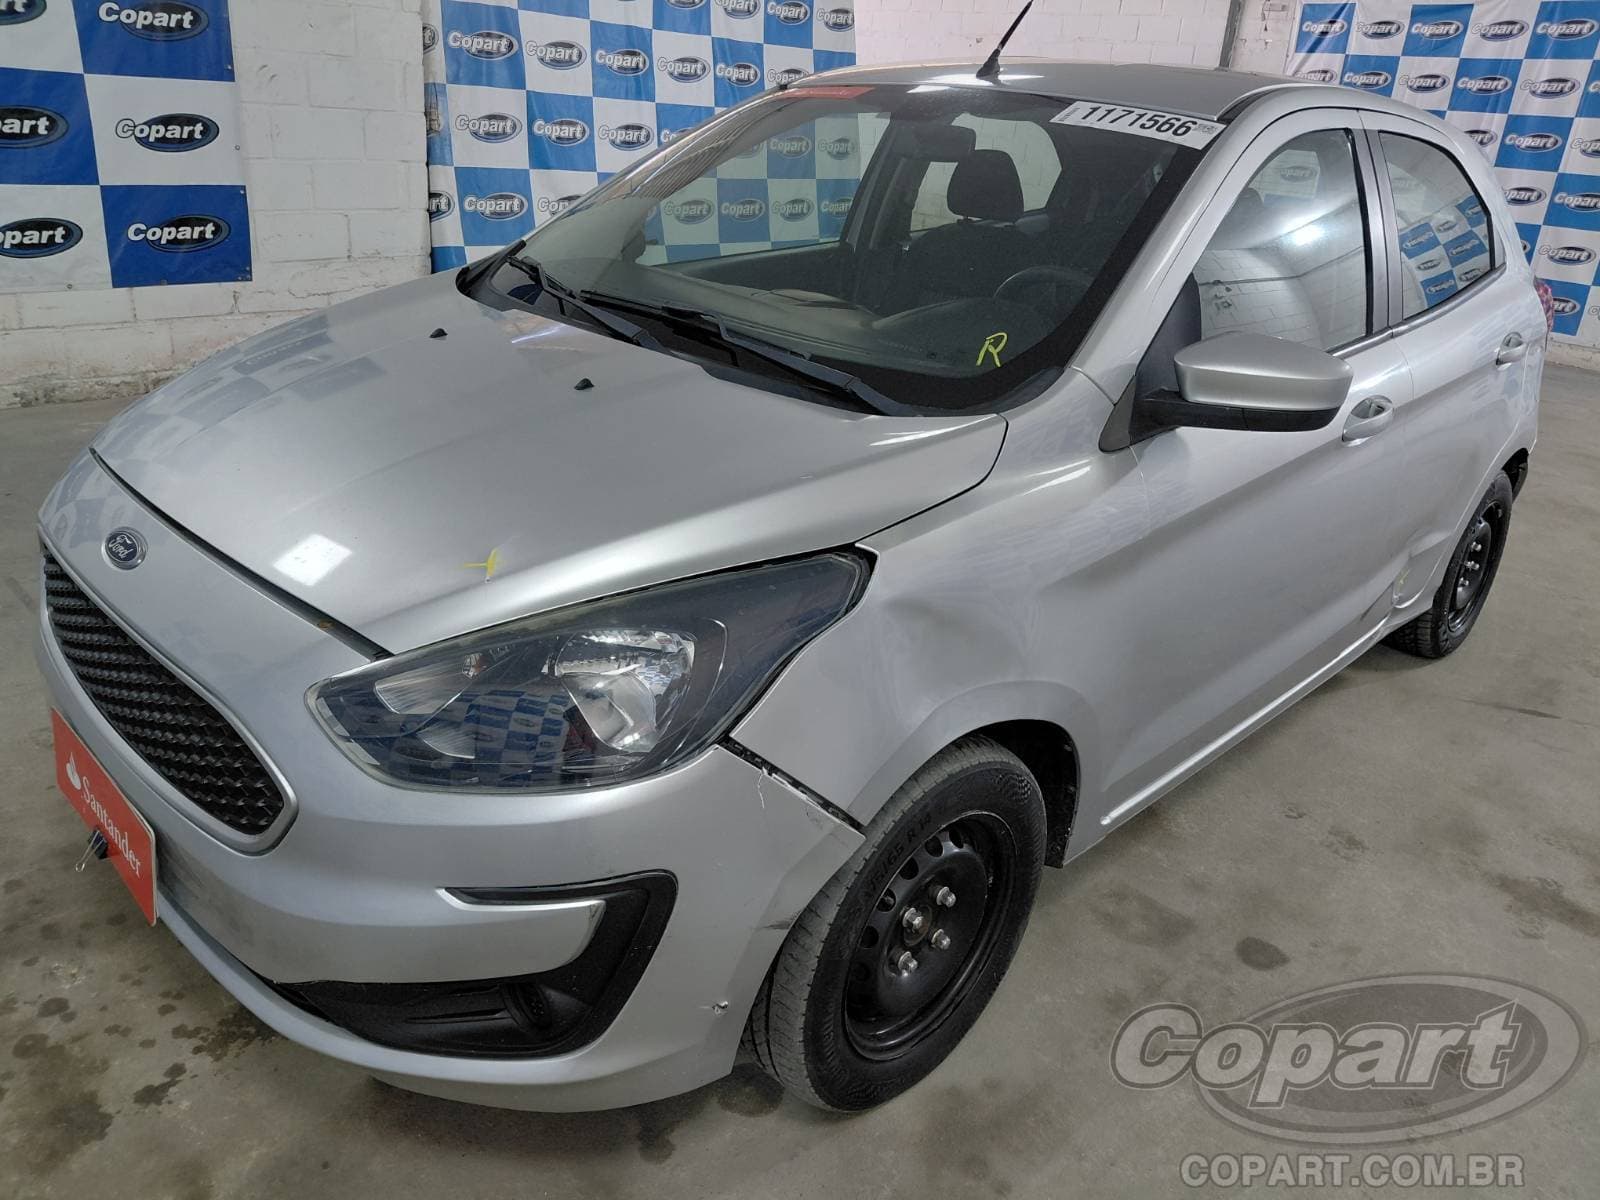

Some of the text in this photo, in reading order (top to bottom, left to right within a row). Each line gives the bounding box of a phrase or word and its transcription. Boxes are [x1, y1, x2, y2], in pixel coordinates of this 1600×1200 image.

[99, 2, 194, 28] Copart
[767, 2, 805, 19] Copart
[817, 9, 854, 25] Copart
[1356, 22, 1397, 34] Copart
[1411, 22, 1455, 36] Copart
[1472, 23, 1519, 36] Copart
[1537, 21, 1591, 36] Copart
[449, 32, 508, 53] Copart
[526, 41, 581, 62] Copart
[595, 51, 646, 69] Copart
[657, 57, 703, 76] Copart
[716, 65, 755, 82] Copart
[1343, 73, 1385, 86] Copart
[1400, 74, 1443, 88] Copart
[1457, 77, 1504, 92] Copart
[1520, 80, 1572, 94] Copart
[456, 115, 513, 134] Copart
[533, 120, 583, 138] Copart
[1082, 105, 1197, 137] 1171566
[116, 119, 203, 141] Copart
[598, 126, 647, 143] Copart
[1505, 134, 1554, 149] Copart
[464, 197, 521, 213] Copart
[1554, 192, 1600, 208] Copar
[0, 227, 66, 248] part
[128, 223, 215, 244] Copart
[1540, 246, 1588, 260] Copart
[976, 332, 1008, 367] R
[108, 534, 134, 558] Ford
[82, 775, 142, 878] Santander
